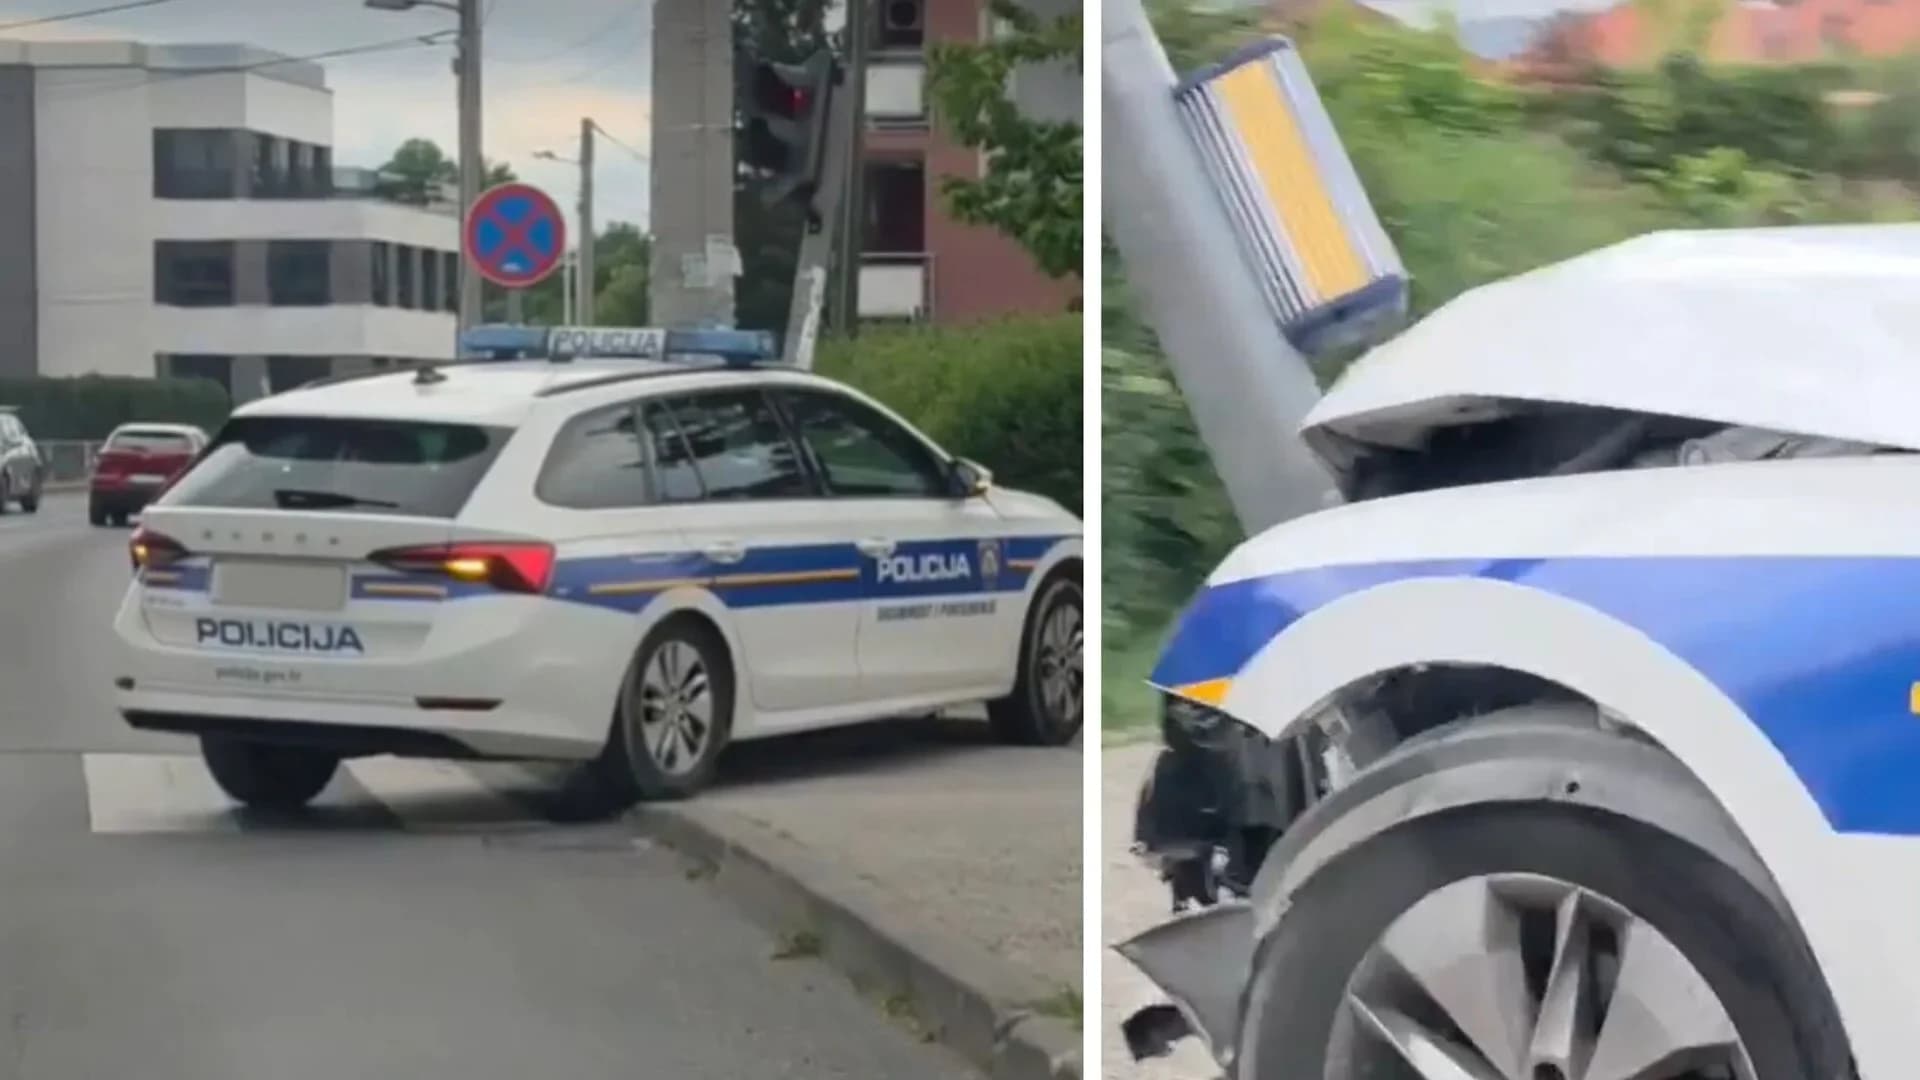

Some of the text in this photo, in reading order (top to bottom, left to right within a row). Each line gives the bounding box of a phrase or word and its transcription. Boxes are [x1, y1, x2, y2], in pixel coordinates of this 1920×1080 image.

[555, 330, 659, 352] POLICIJA
[877, 553, 970, 584] POLICIJA
[196, 618, 364, 652] POLICIJA
